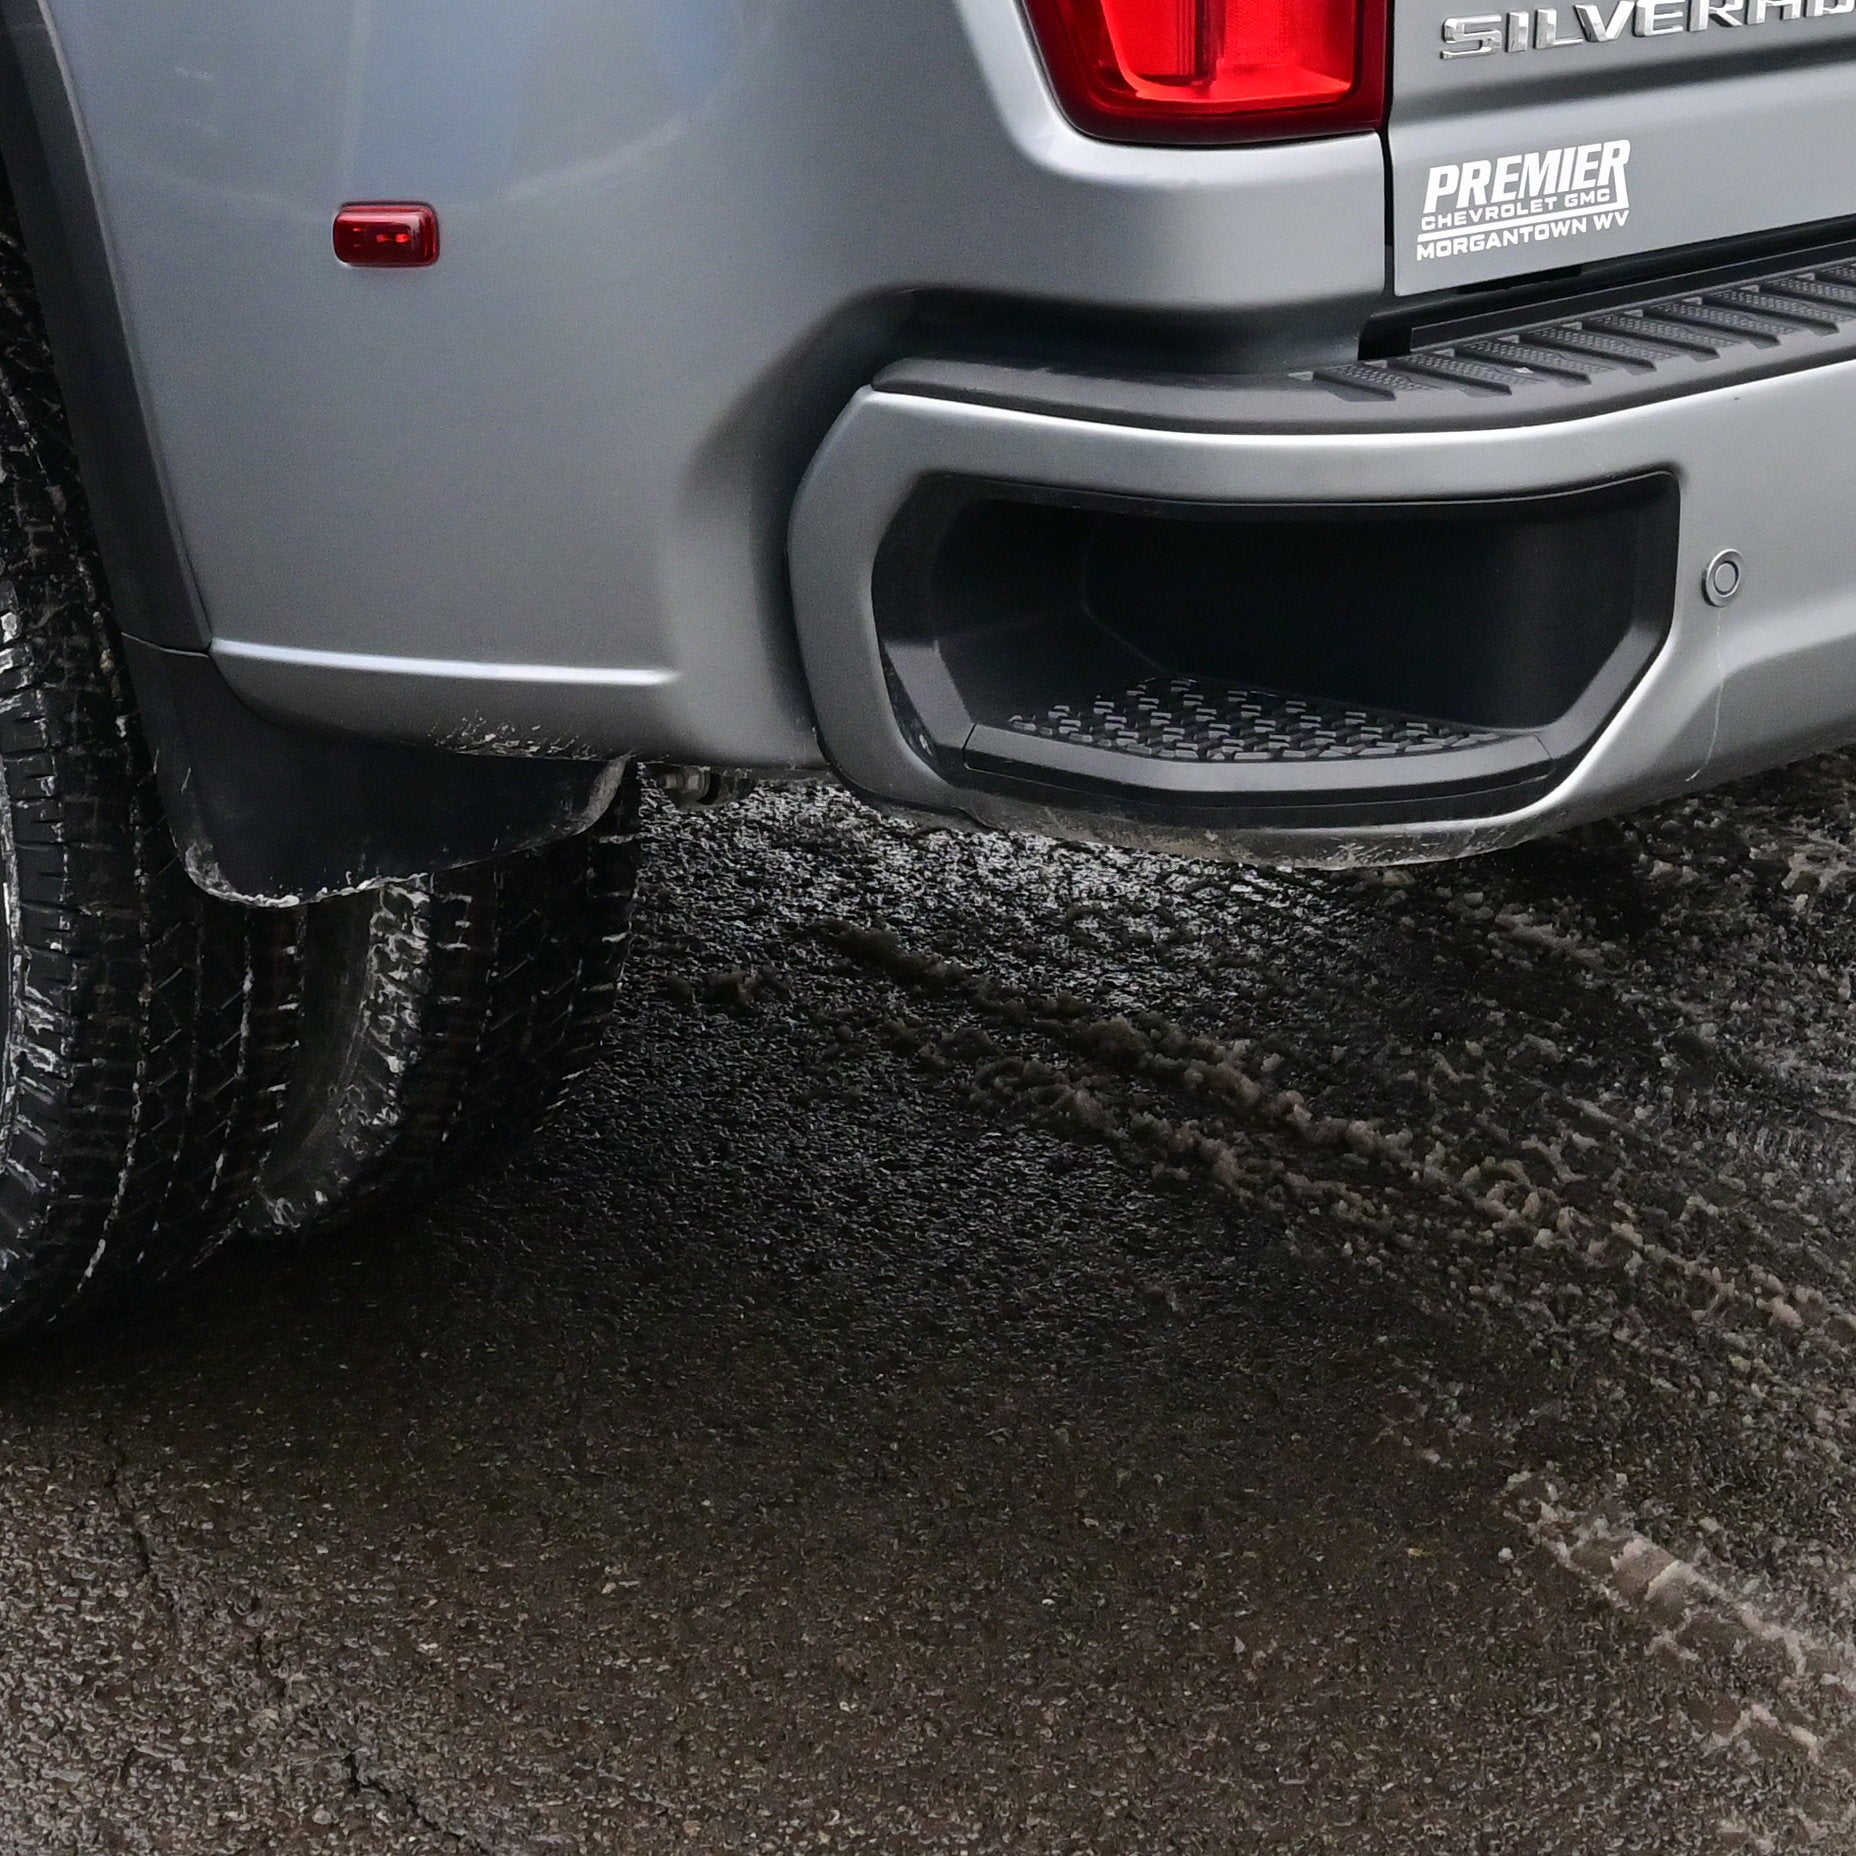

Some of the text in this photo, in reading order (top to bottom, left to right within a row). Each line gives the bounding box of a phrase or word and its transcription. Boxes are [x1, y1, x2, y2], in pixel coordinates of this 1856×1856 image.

[1423, 139, 1631, 214] PREMIER
[1421, 188, 1610, 231] CHEVROLET GMC
[1416, 210, 1630, 261] MORGANTOWN WV
